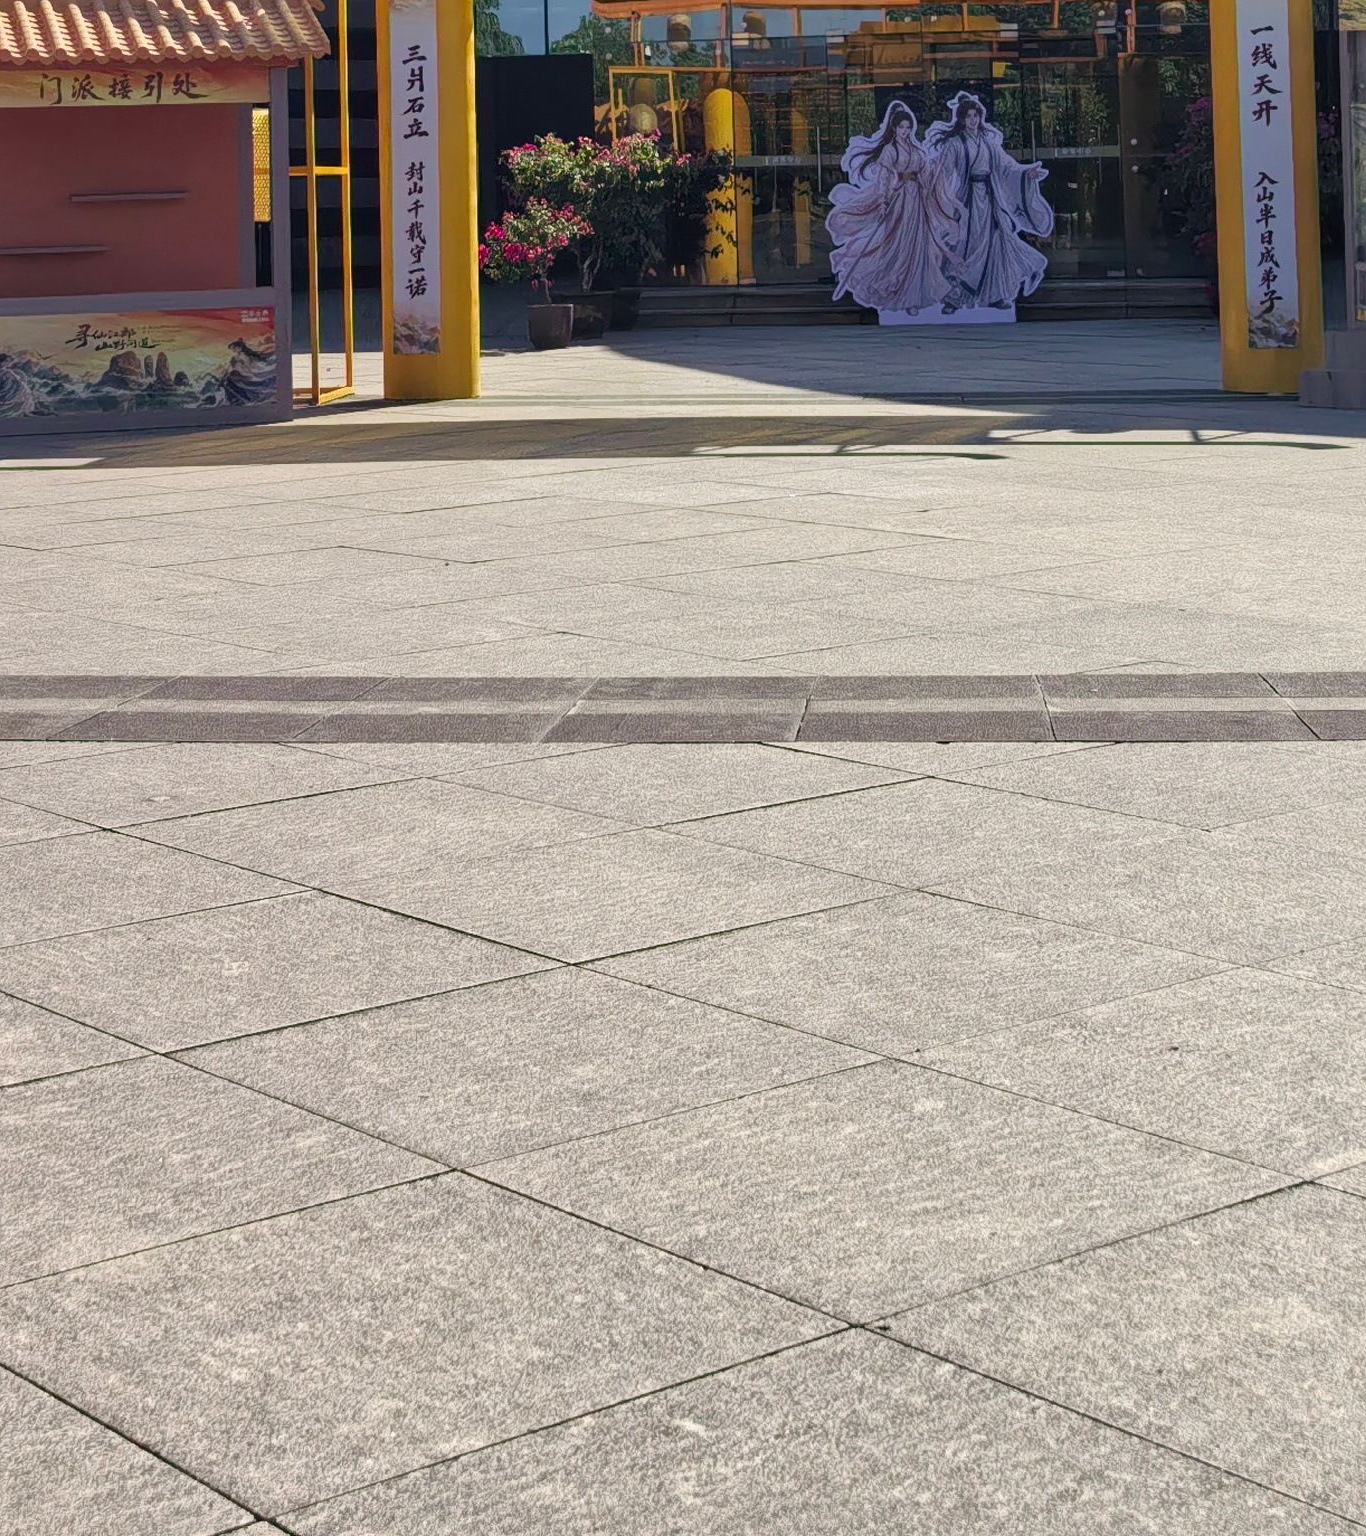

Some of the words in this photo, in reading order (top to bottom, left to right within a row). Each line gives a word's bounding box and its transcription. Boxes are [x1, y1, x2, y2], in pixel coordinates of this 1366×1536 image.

[39, 71, 211, 105] 门派接引处
[1250, 25, 1283, 127] 一线天开
[405, 161, 428, 301] 封山千载守一诺
[1254, 171, 1283, 316] 入山半日成弟子
